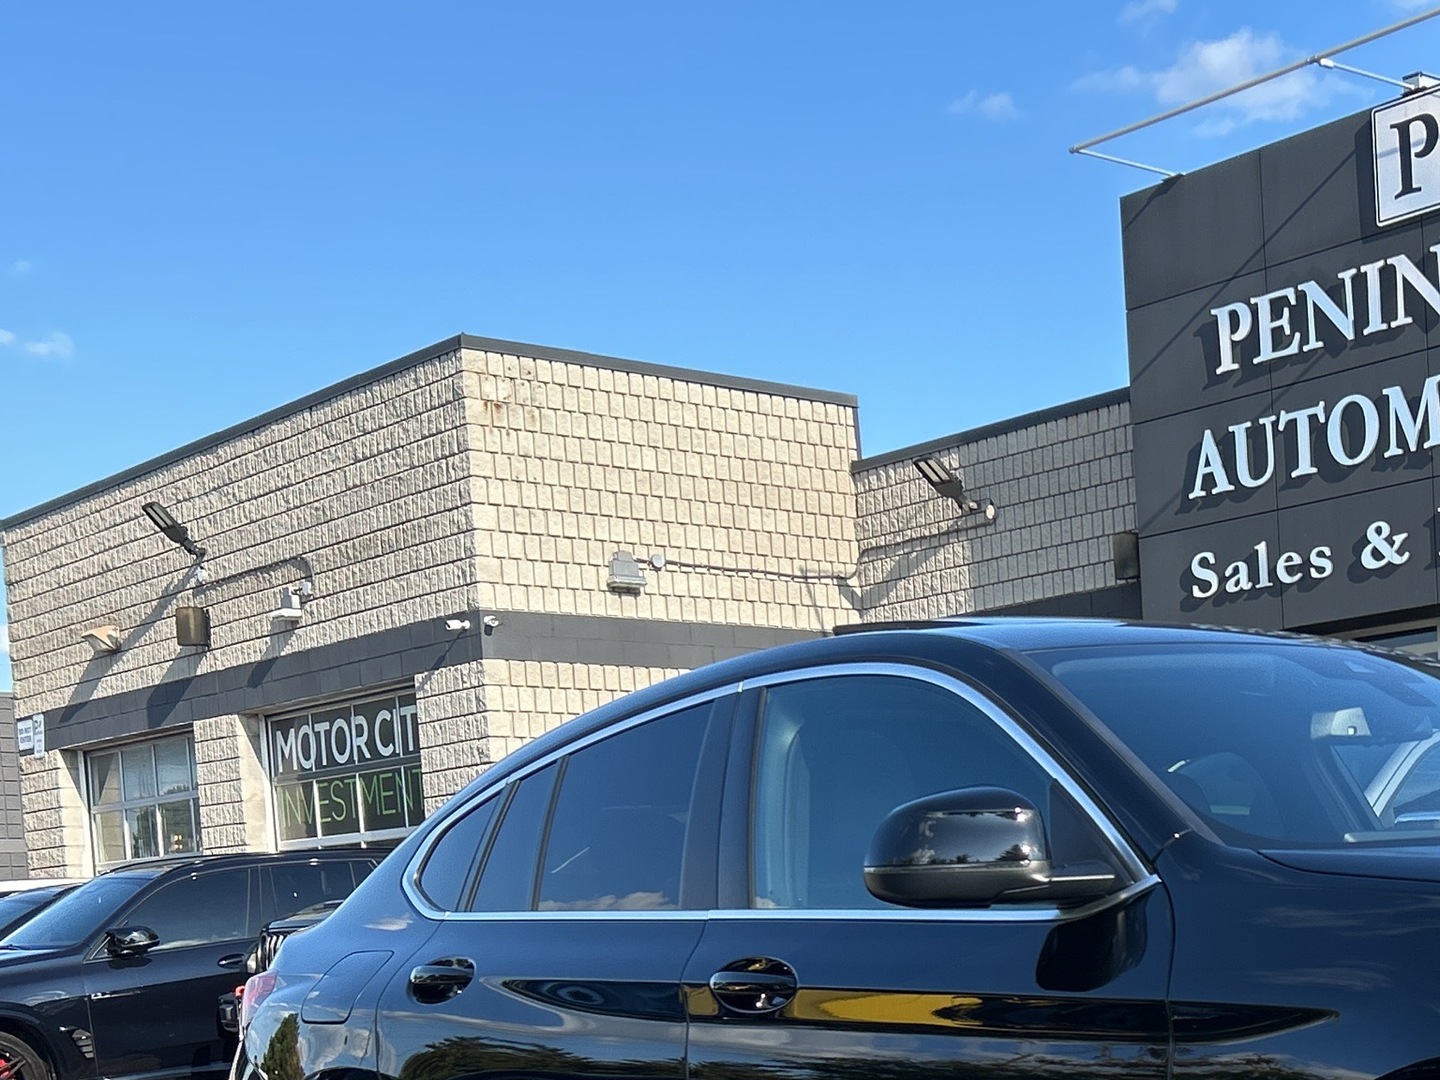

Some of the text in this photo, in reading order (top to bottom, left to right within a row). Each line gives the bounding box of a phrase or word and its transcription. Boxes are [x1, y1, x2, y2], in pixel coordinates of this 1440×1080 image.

[1390, 111, 1440, 201] P
[1191, 541, 1334, 599] Sales
[1361, 520, 1410, 570] &
[275, 715, 371, 773] MOTOR
